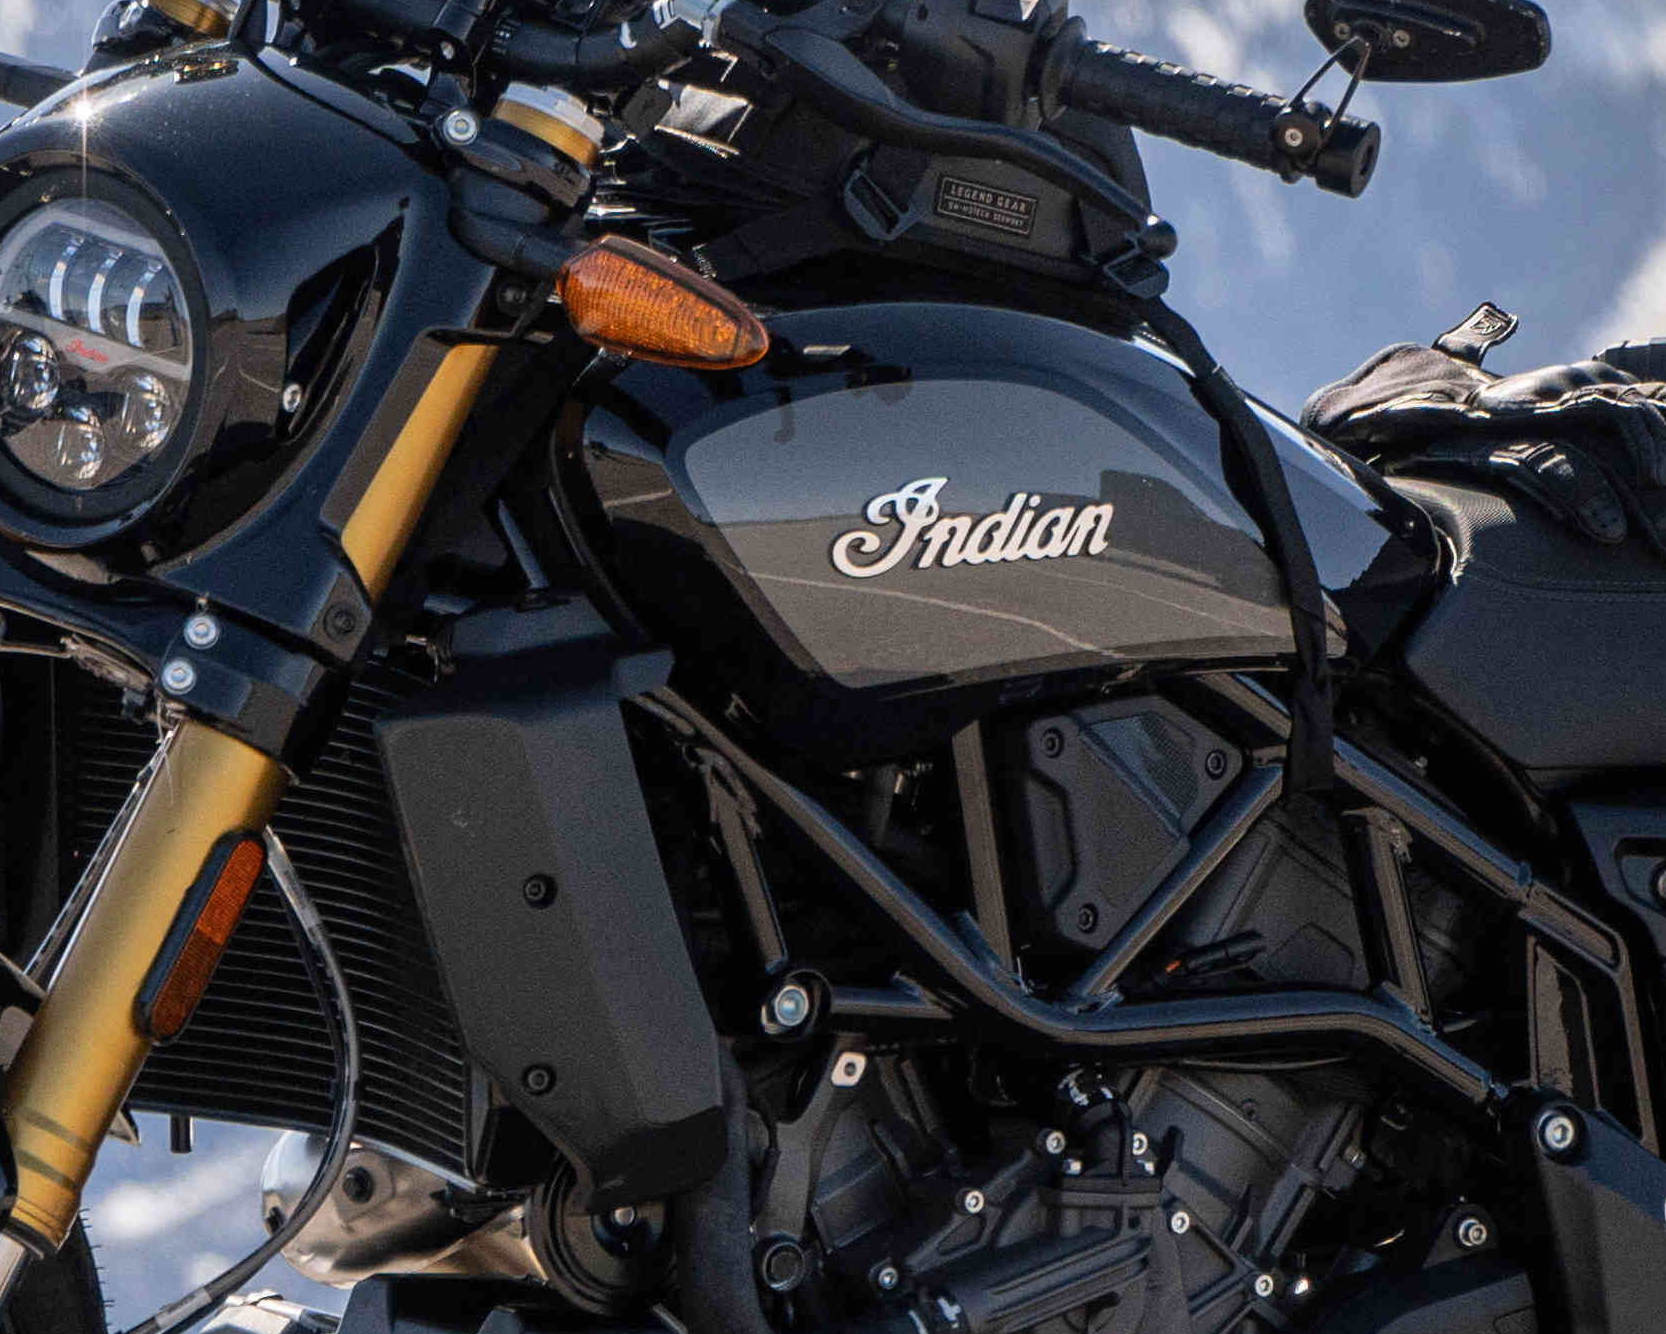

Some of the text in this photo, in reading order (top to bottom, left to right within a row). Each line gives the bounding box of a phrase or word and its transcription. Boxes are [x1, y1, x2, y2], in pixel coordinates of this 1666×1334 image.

[951, 185, 1026, 213] LEGEND GEAR
[831, 476, 1115, 579] Indian
